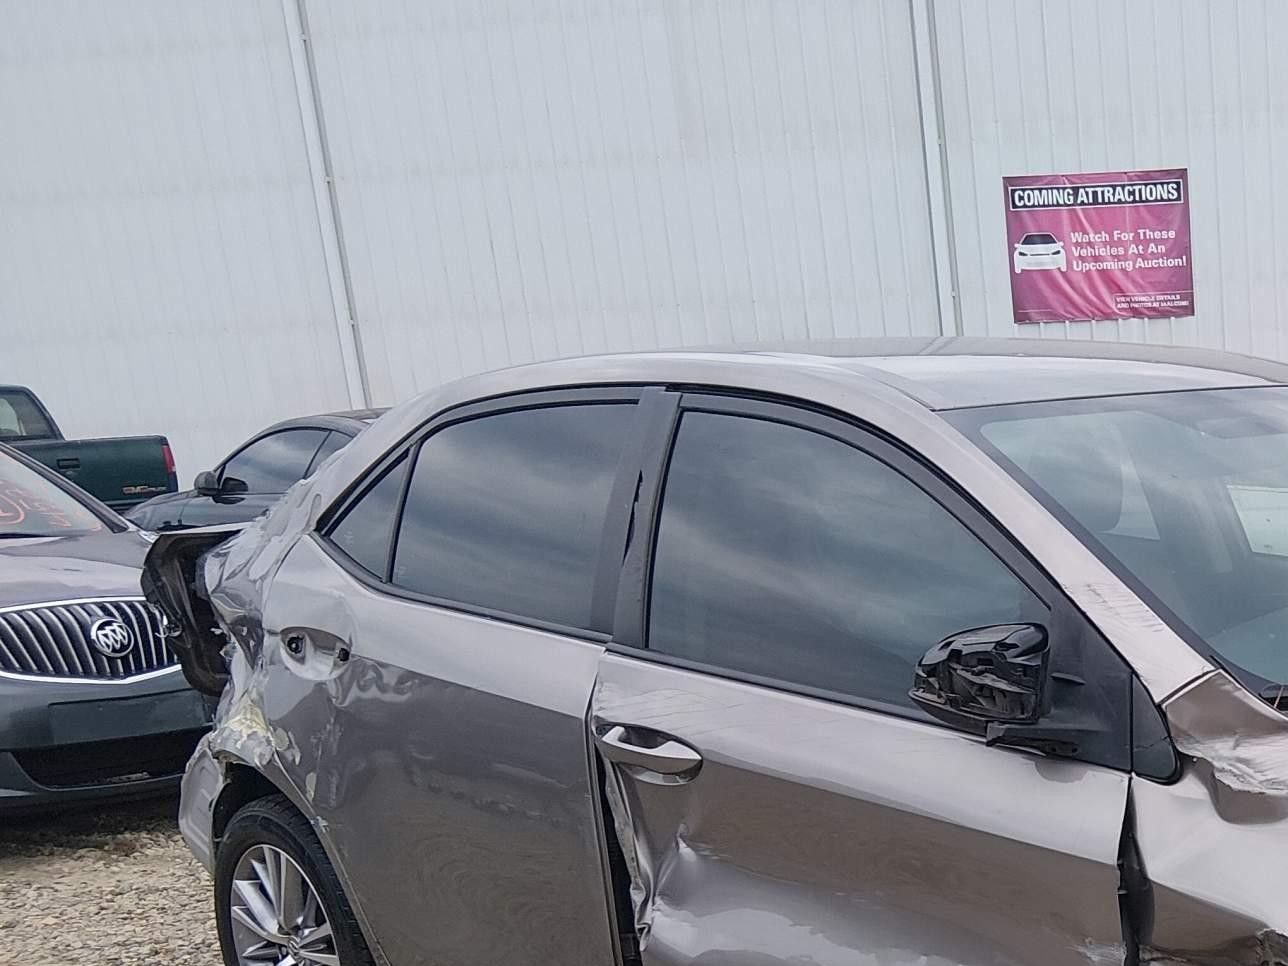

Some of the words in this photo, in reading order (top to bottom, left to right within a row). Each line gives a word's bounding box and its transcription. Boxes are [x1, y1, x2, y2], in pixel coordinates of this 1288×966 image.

[1014, 189, 1074, 207] COMING
[1077, 183, 1178, 204] ATTRACTIONS
[1071, 231, 1110, 243] Watch
[1113, 230, 1135, 241] For
[1138, 229, 1176, 240] These
[1072, 245, 1125, 257] Vehicles
[1128, 244, 1144, 255] At
[1147, 243, 1166, 254] An
[1073, 258, 1133, 272] Upcoming
[1135, 256, 1187, 269] Auction!
